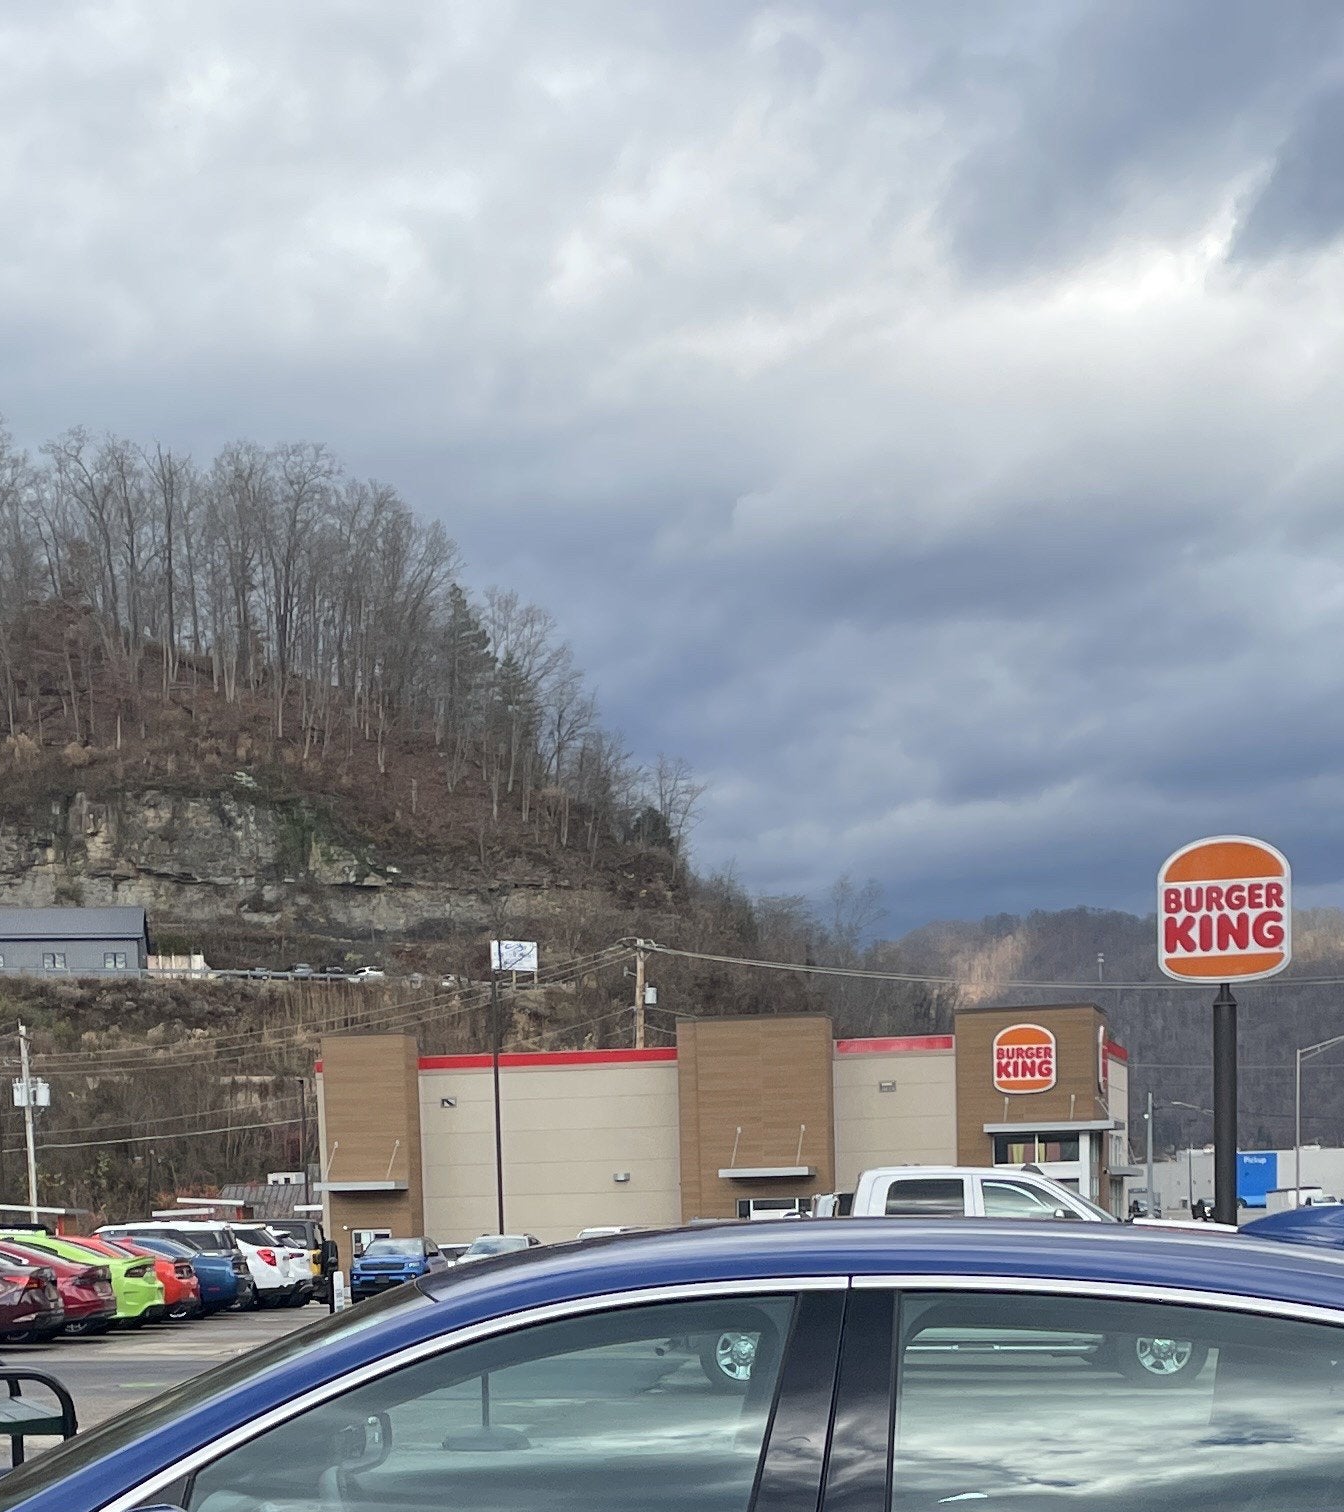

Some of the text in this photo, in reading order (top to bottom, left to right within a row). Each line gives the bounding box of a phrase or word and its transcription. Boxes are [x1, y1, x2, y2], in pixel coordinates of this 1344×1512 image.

[1164, 882, 1285, 914] BURGER
[1164, 911, 1285, 953] KING
[997, 1047, 1052, 1060] BURGER
[997, 1060, 1053, 1078] KING
